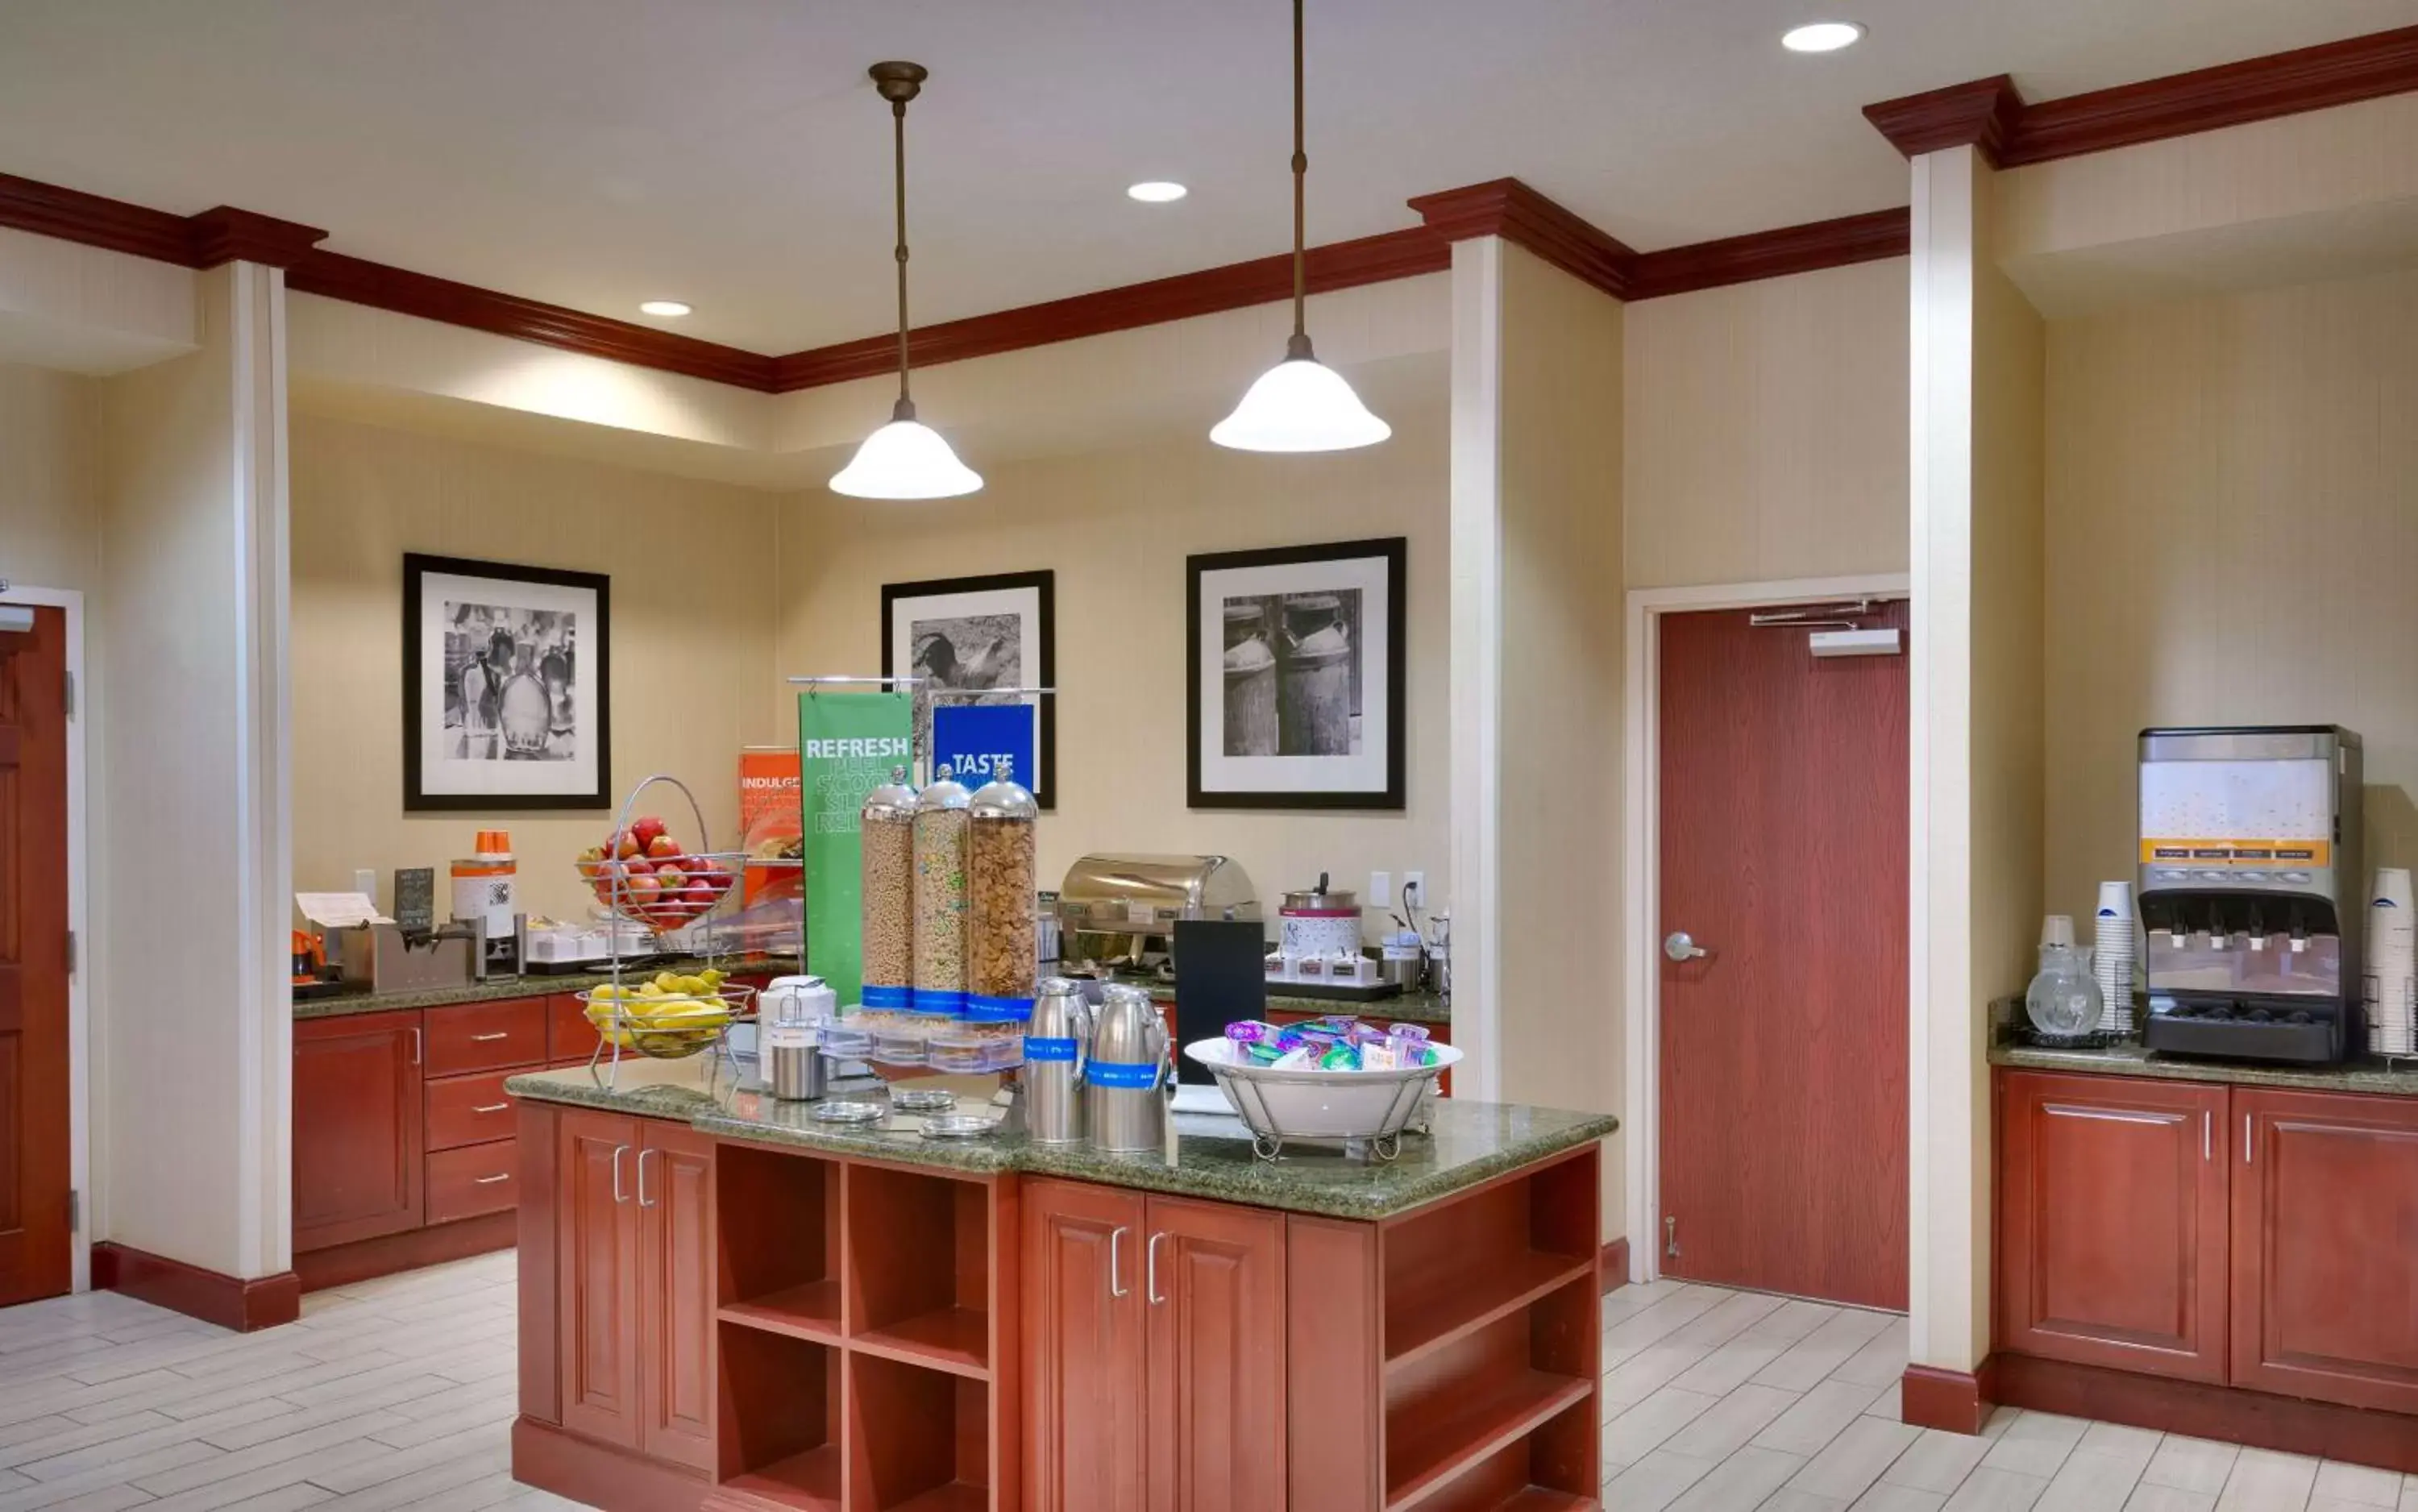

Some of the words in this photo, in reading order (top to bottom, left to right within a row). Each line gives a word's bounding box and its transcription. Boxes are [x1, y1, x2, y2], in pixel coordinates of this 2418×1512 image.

[807, 737, 908, 758] REFRESH
[829, 758, 888, 775] PEEL
[952, 754, 1014, 775] TASTE
[742, 776, 800, 788] INDULGE
[816, 774, 890, 793] SCOO
